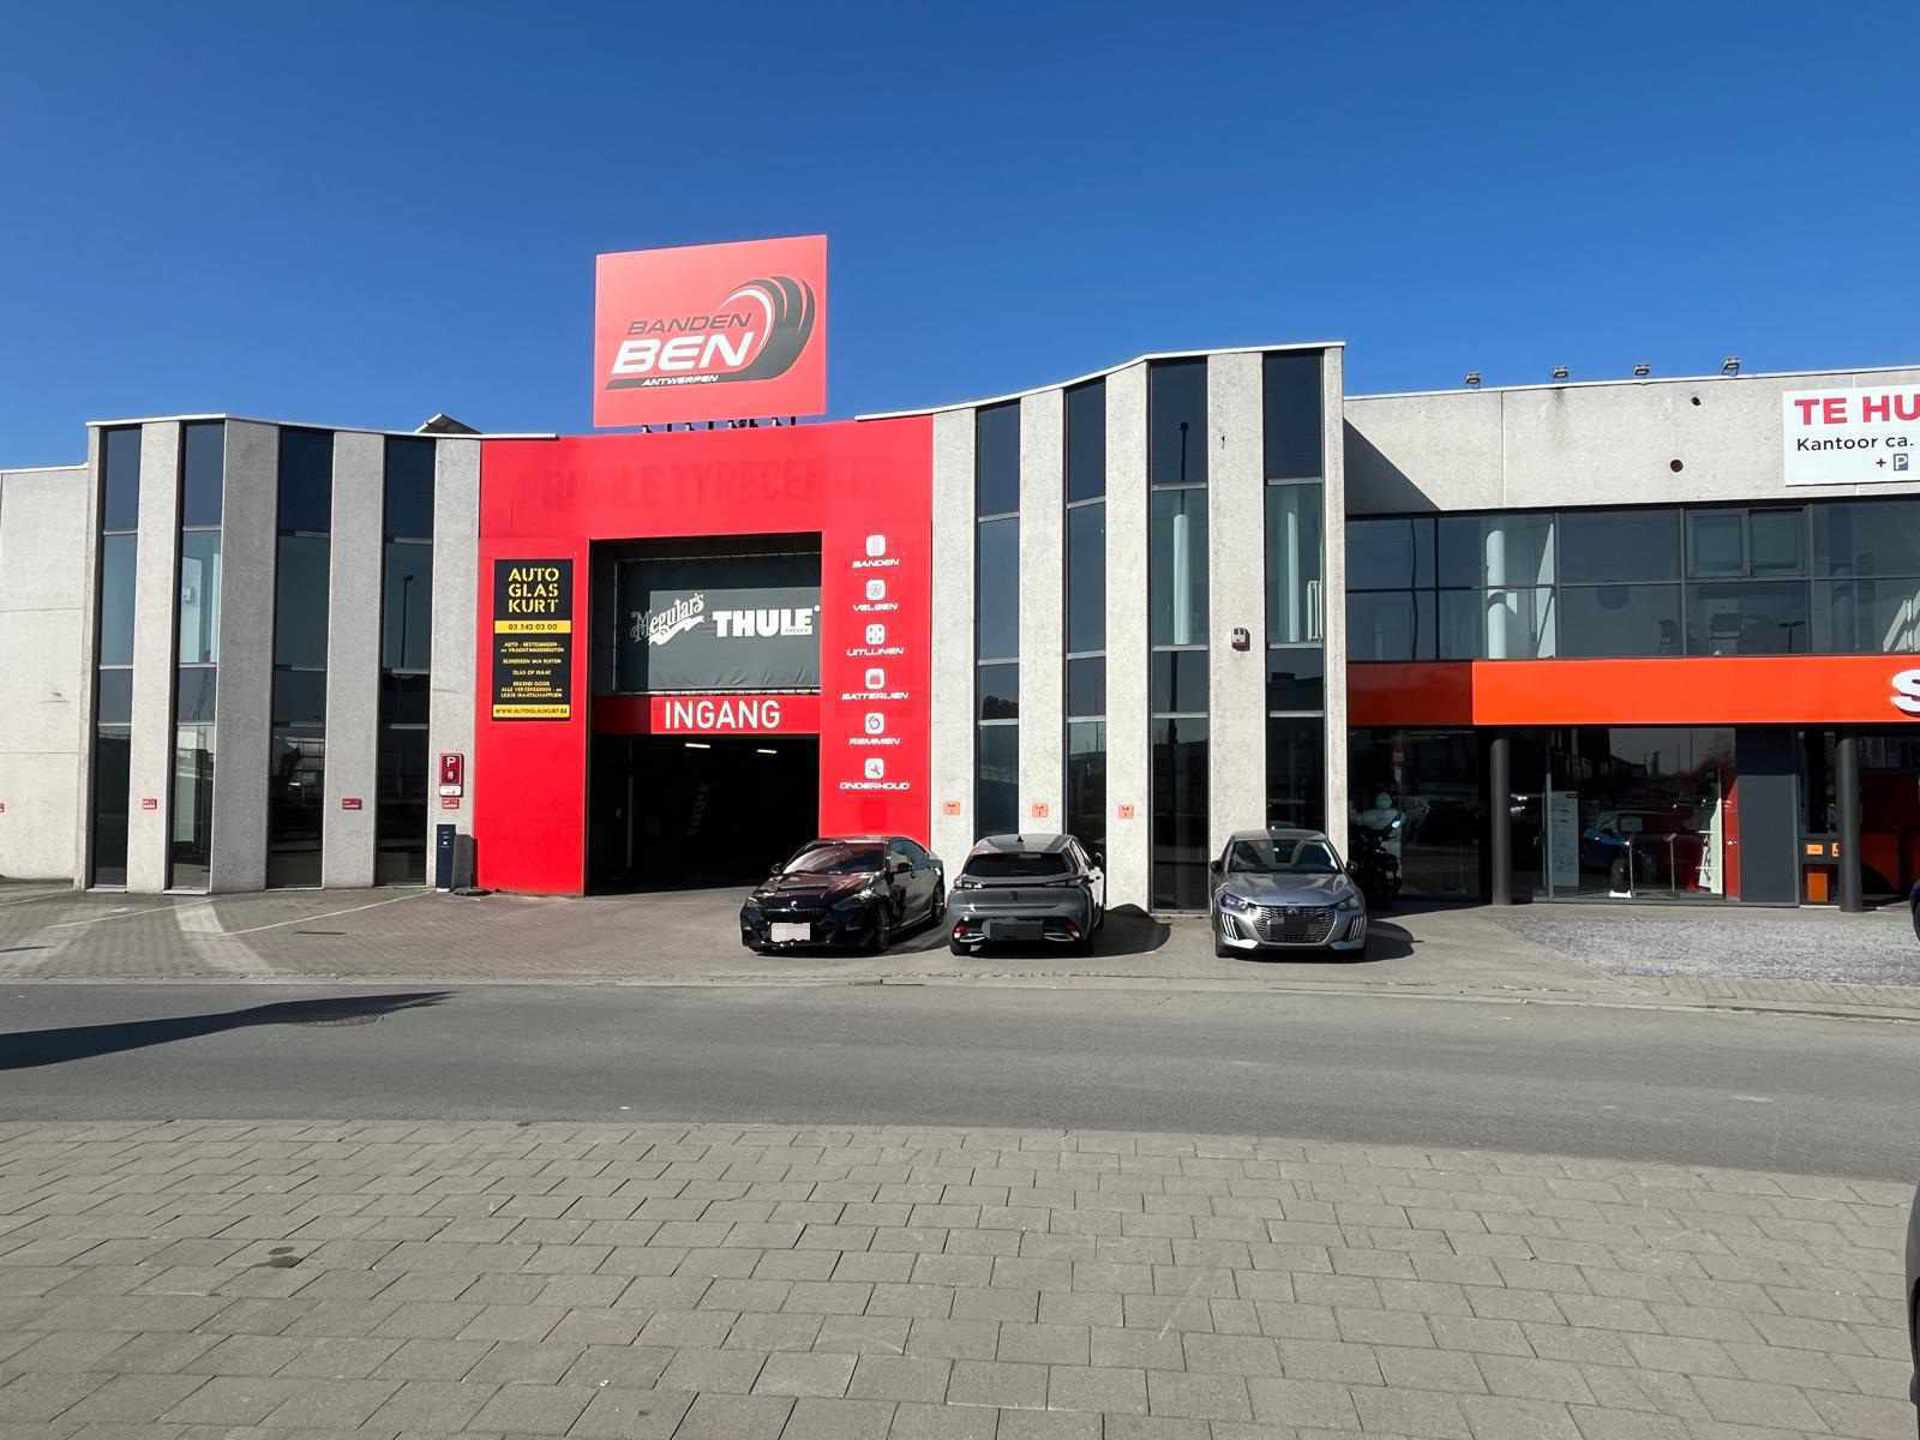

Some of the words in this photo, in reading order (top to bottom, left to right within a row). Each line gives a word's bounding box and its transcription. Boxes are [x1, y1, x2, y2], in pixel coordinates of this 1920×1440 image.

[628, 313, 753, 335] BANDEN
[611, 332, 755, 374] BEN
[641, 374, 720, 387] ANTWERPEN
[1794, 397, 1848, 426] TE
[1797, 436, 1878, 452] Kantoor
[1885, 436, 1914, 449] ca.
[852, 558, 900, 570] BANDEN
[508, 567, 559, 582] AUTO
[508, 583, 559, 598] GLAS
[508, 599, 559, 614] KURT
[712, 607, 814, 638] THULE
[664, 699, 781, 729] INGANG
[446, 756, 457, 768] P
